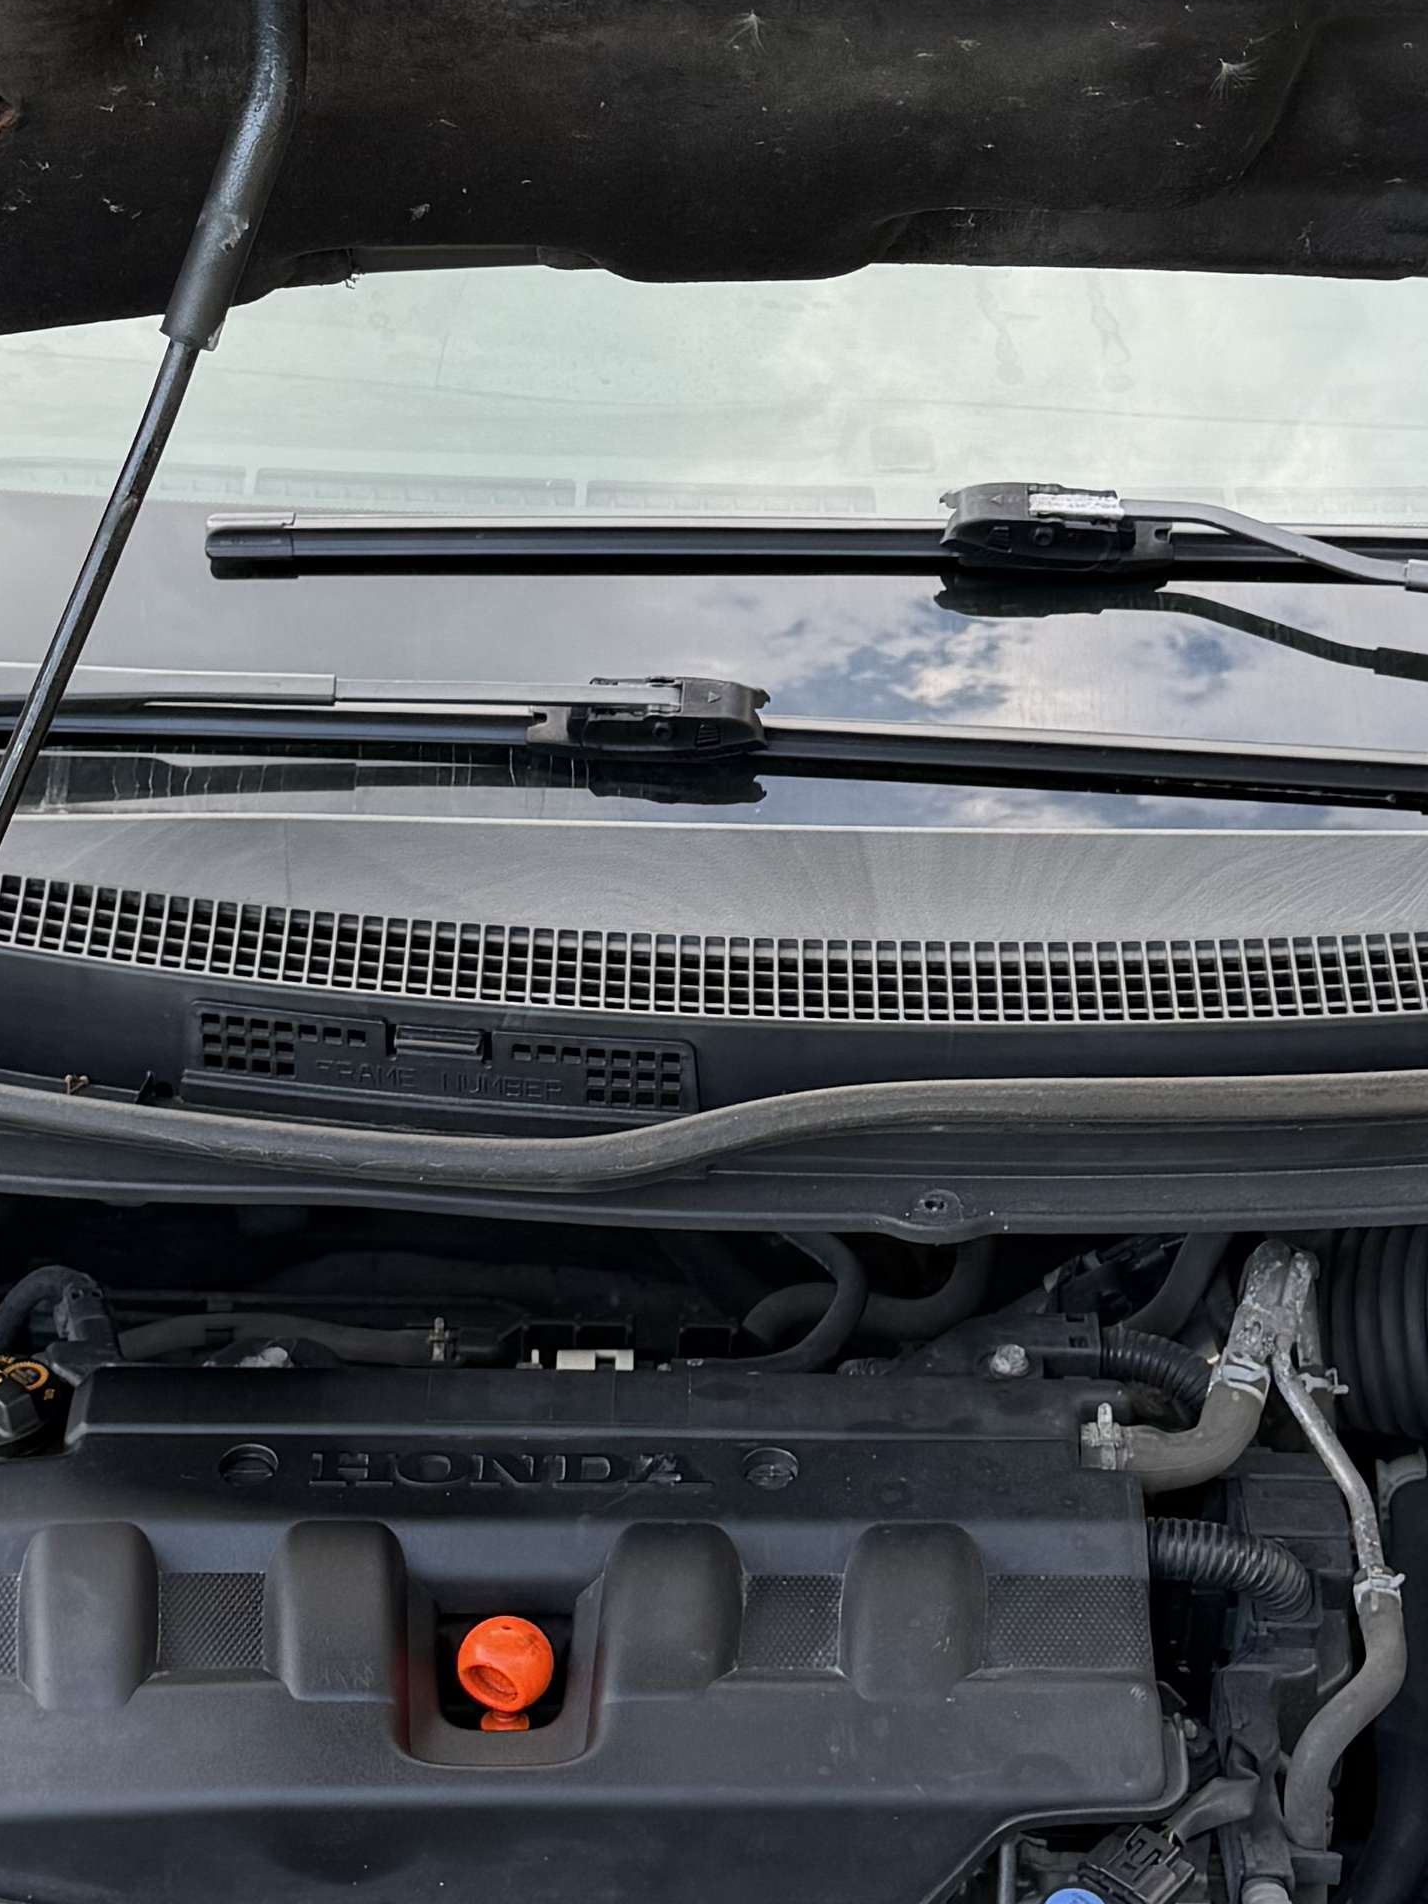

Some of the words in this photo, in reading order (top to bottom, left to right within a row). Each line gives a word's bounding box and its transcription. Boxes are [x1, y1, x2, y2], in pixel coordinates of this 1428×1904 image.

[315, 1058, 417, 1089] FRAME
[439, 1066, 565, 1098] NUMBER
[308, 1451, 715, 1489] HONDA
